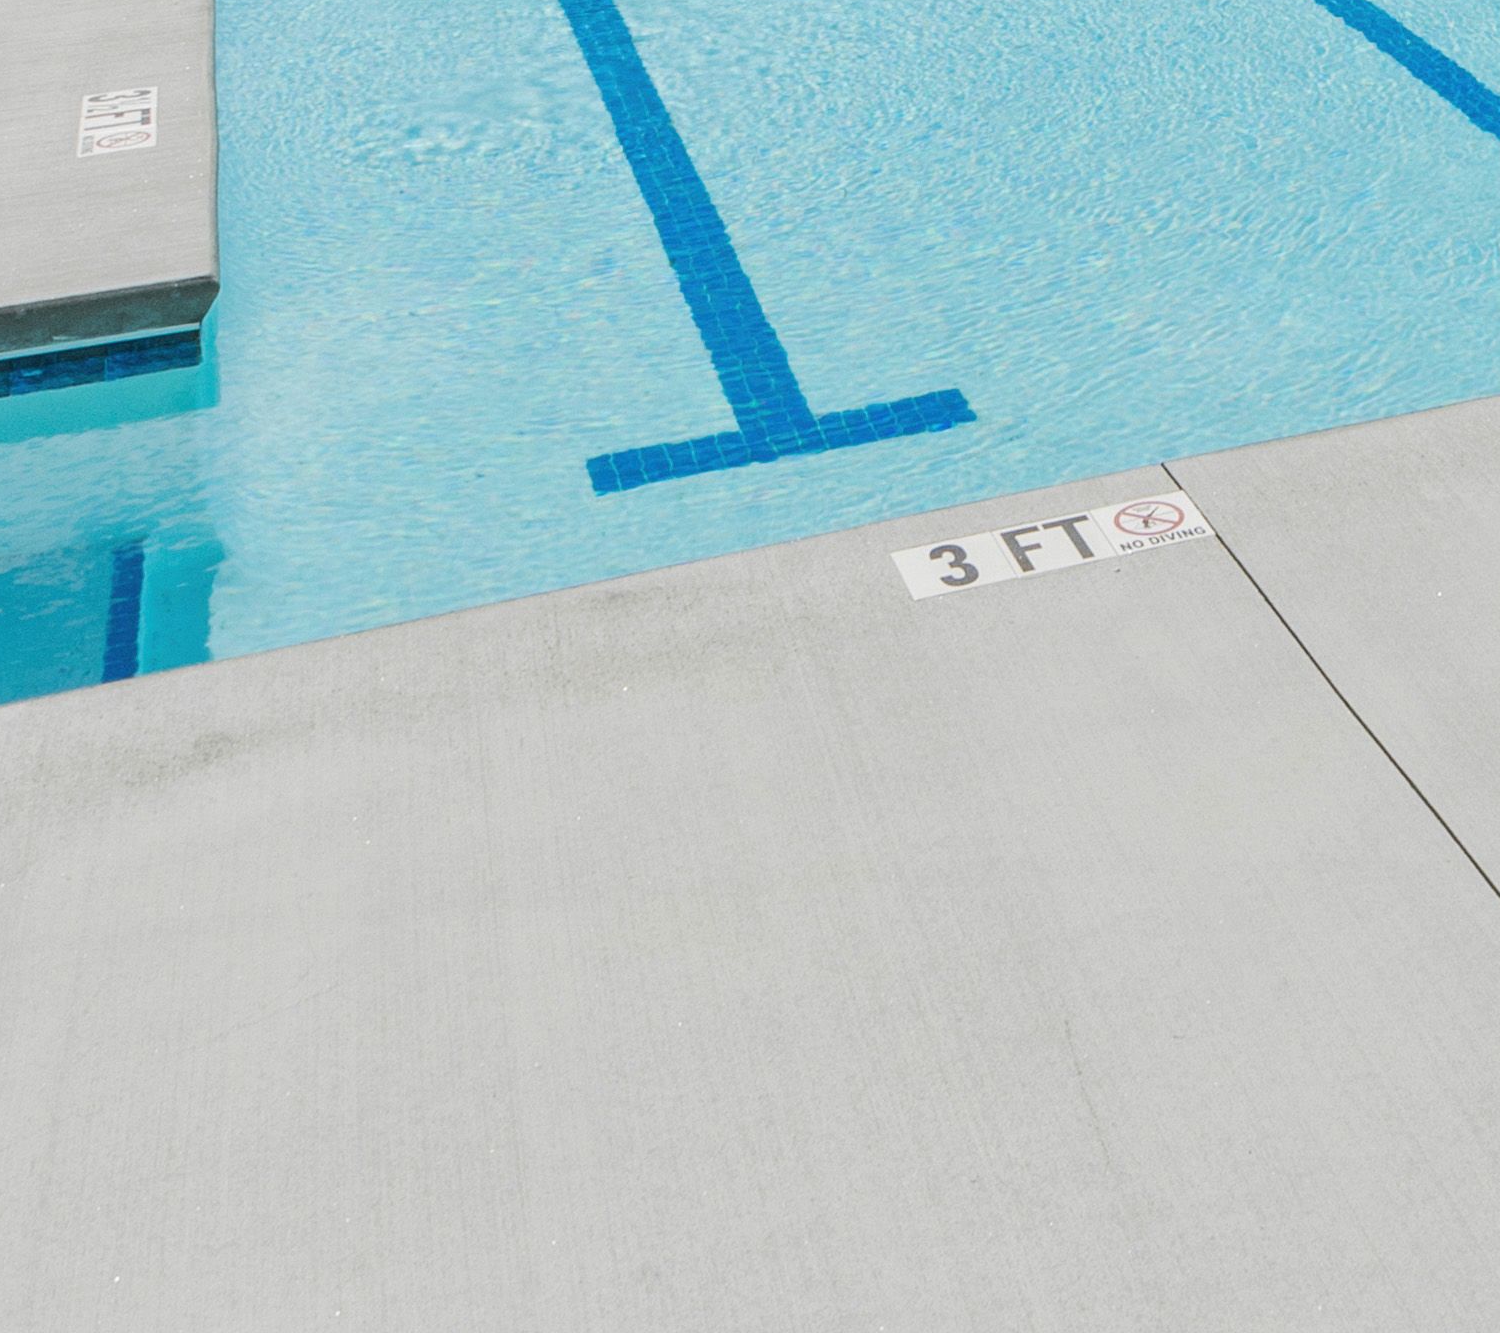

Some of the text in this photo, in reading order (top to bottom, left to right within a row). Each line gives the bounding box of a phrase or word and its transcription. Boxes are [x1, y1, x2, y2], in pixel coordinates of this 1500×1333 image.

[84, 108, 151, 131] FT
[929, 515, 1094, 586] 3 FT
[1120, 526, 1206, 551] NO DIVING
